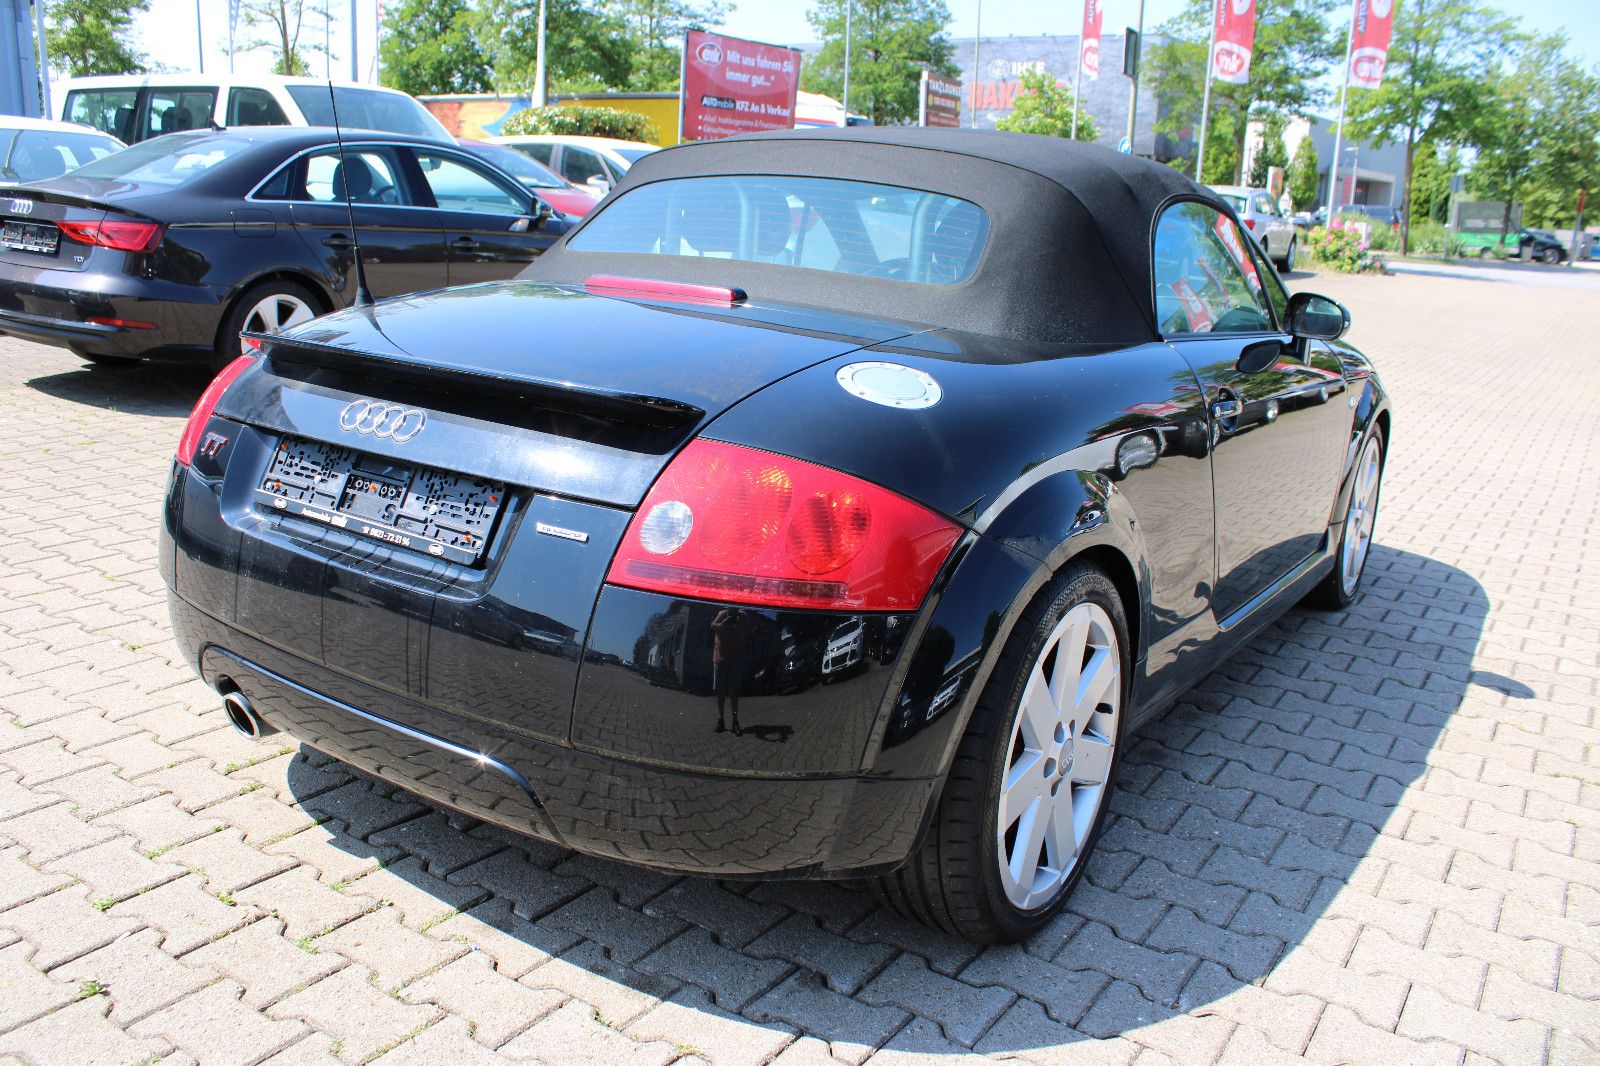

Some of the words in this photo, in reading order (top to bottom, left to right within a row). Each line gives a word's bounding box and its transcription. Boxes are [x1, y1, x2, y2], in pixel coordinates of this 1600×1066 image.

[726, 50, 741, 64] Mit
[742, 55, 756, 67] uns
[757, 55, 781, 71] fahren
[725, 67, 751, 83] immer
[735, 100, 750, 112] KFZ
[750, 101, 760, 113] An
[200, 431, 230, 457] TT
